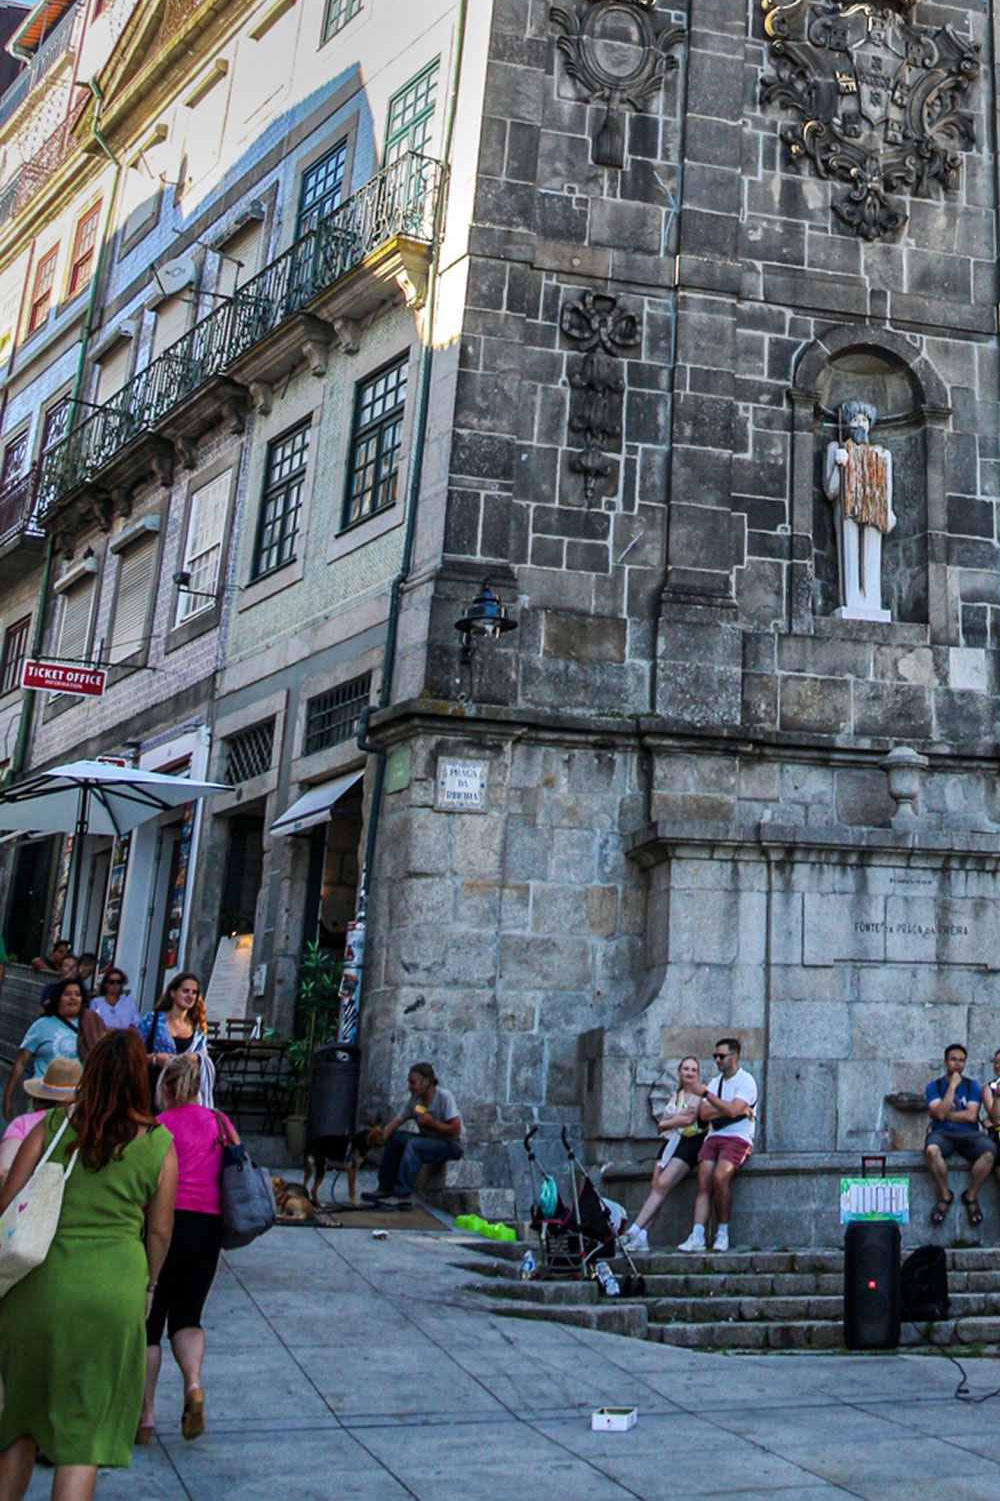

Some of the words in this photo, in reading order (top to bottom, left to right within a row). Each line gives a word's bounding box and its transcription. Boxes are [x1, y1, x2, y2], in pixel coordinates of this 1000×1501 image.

[28, 666, 64, 680] TICKET
[66, 672, 102, 686] OFFICE
[458, 779, 468, 788] DA
[854, 922, 880, 933] FONTE
